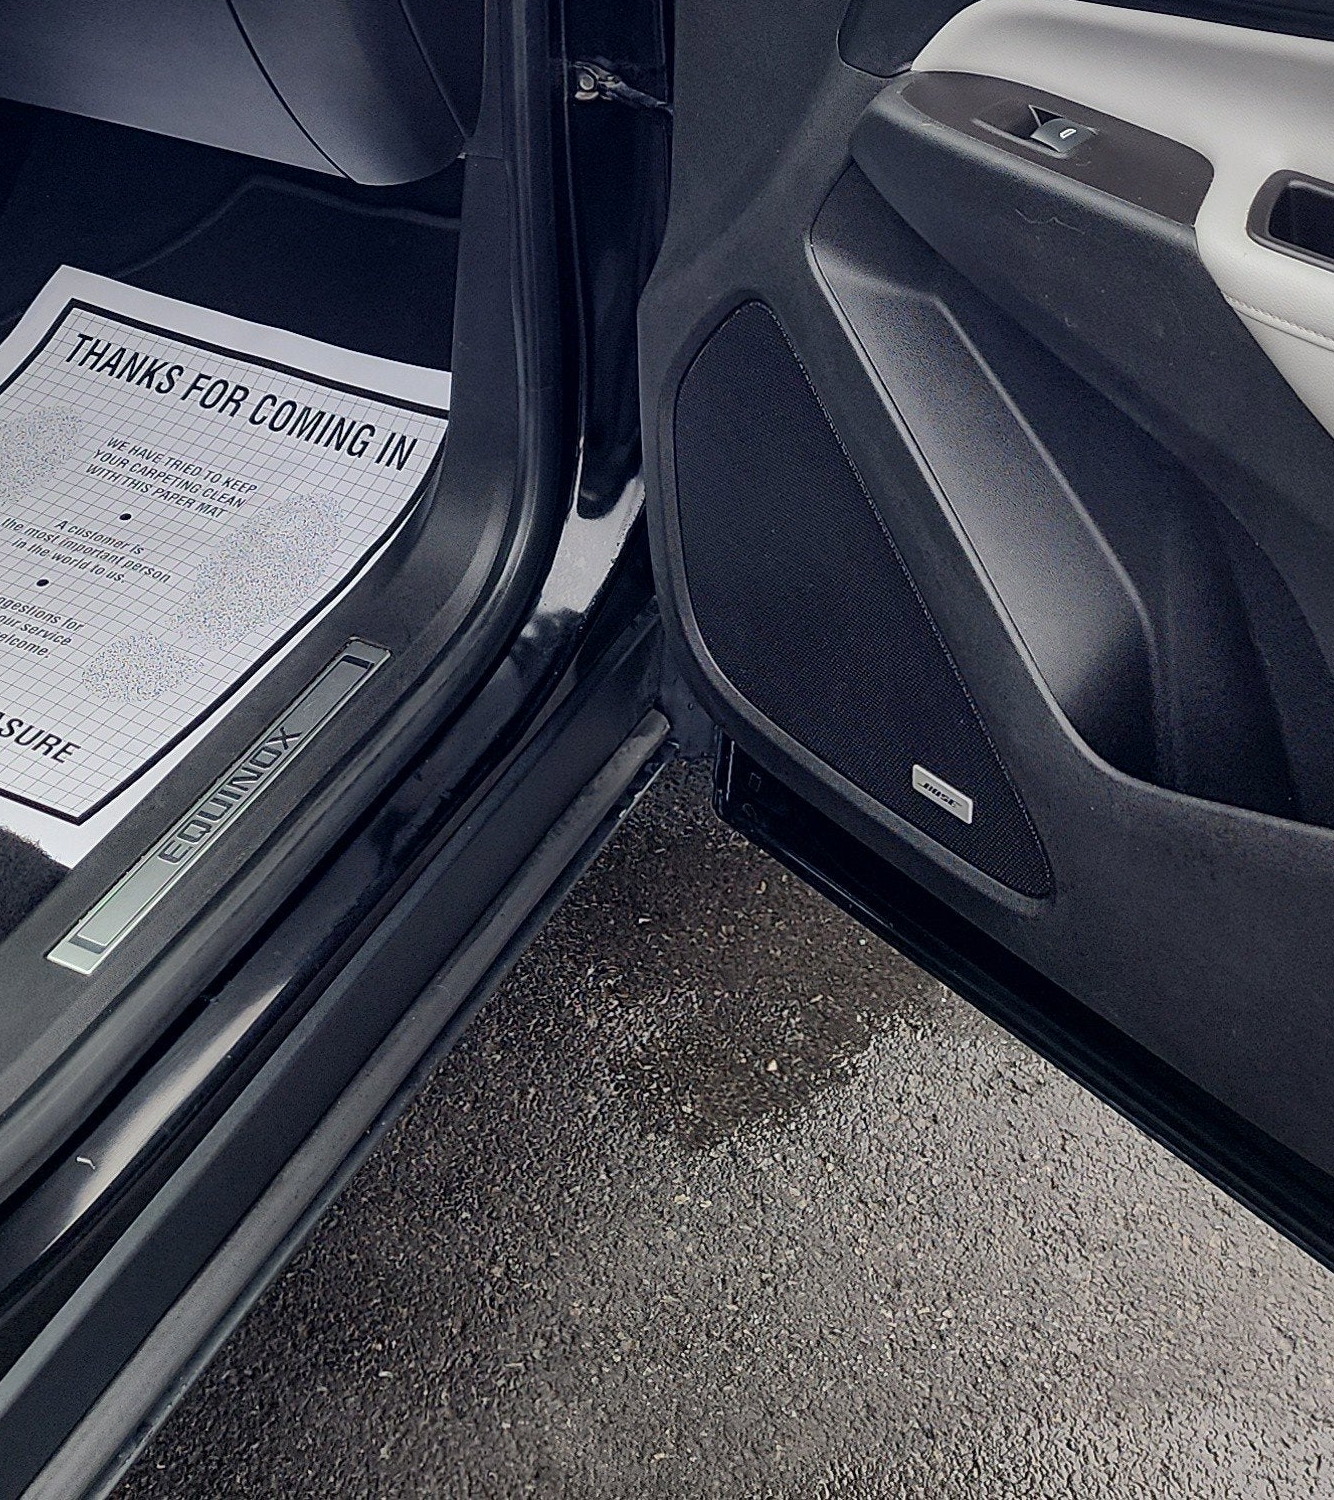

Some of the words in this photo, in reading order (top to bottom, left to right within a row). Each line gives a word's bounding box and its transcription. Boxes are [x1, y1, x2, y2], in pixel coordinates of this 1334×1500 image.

[66, 333, 184, 394] THANKS
[180, 373, 250, 418] FOR
[248, 394, 376, 458] COMING
[375, 432, 418, 472] IN
[86, 463, 122, 482] WITH
[121, 476, 153, 493] THIS
[151, 488, 195, 509] PAPER
[195, 502, 228, 519] MAT
[93, 449, 129, 468] YOUR
[129, 462, 202, 493] CARPETING
[202, 488, 247, 508] CLEAN
[107, 437, 130, 452] WE
[128, 446, 165, 464] HAVE
[163, 457, 203, 477] TRIED
[203, 470, 222, 484] TO
[222, 477, 258, 494] KEEP
[1, 517, 24, 532] the
[23, 527, 60, 544] most
[60, 538, 125, 565] important
[121, 559, 171, 583] person
[12, 538, 27, 550] in
[27, 543, 51, 558] the
[51, 552, 91, 570] world
[90, 564, 105, 575] to
[106, 570, 126, 584] us.
[55, 520, 68, 530] A
[67, 526, 131, 550] customer
[129, 544, 145, 555] is
[20, 622, 72, 646] service
[61, 618, 85, 632] for
[157, 726, 303, 864] EQUINOX
